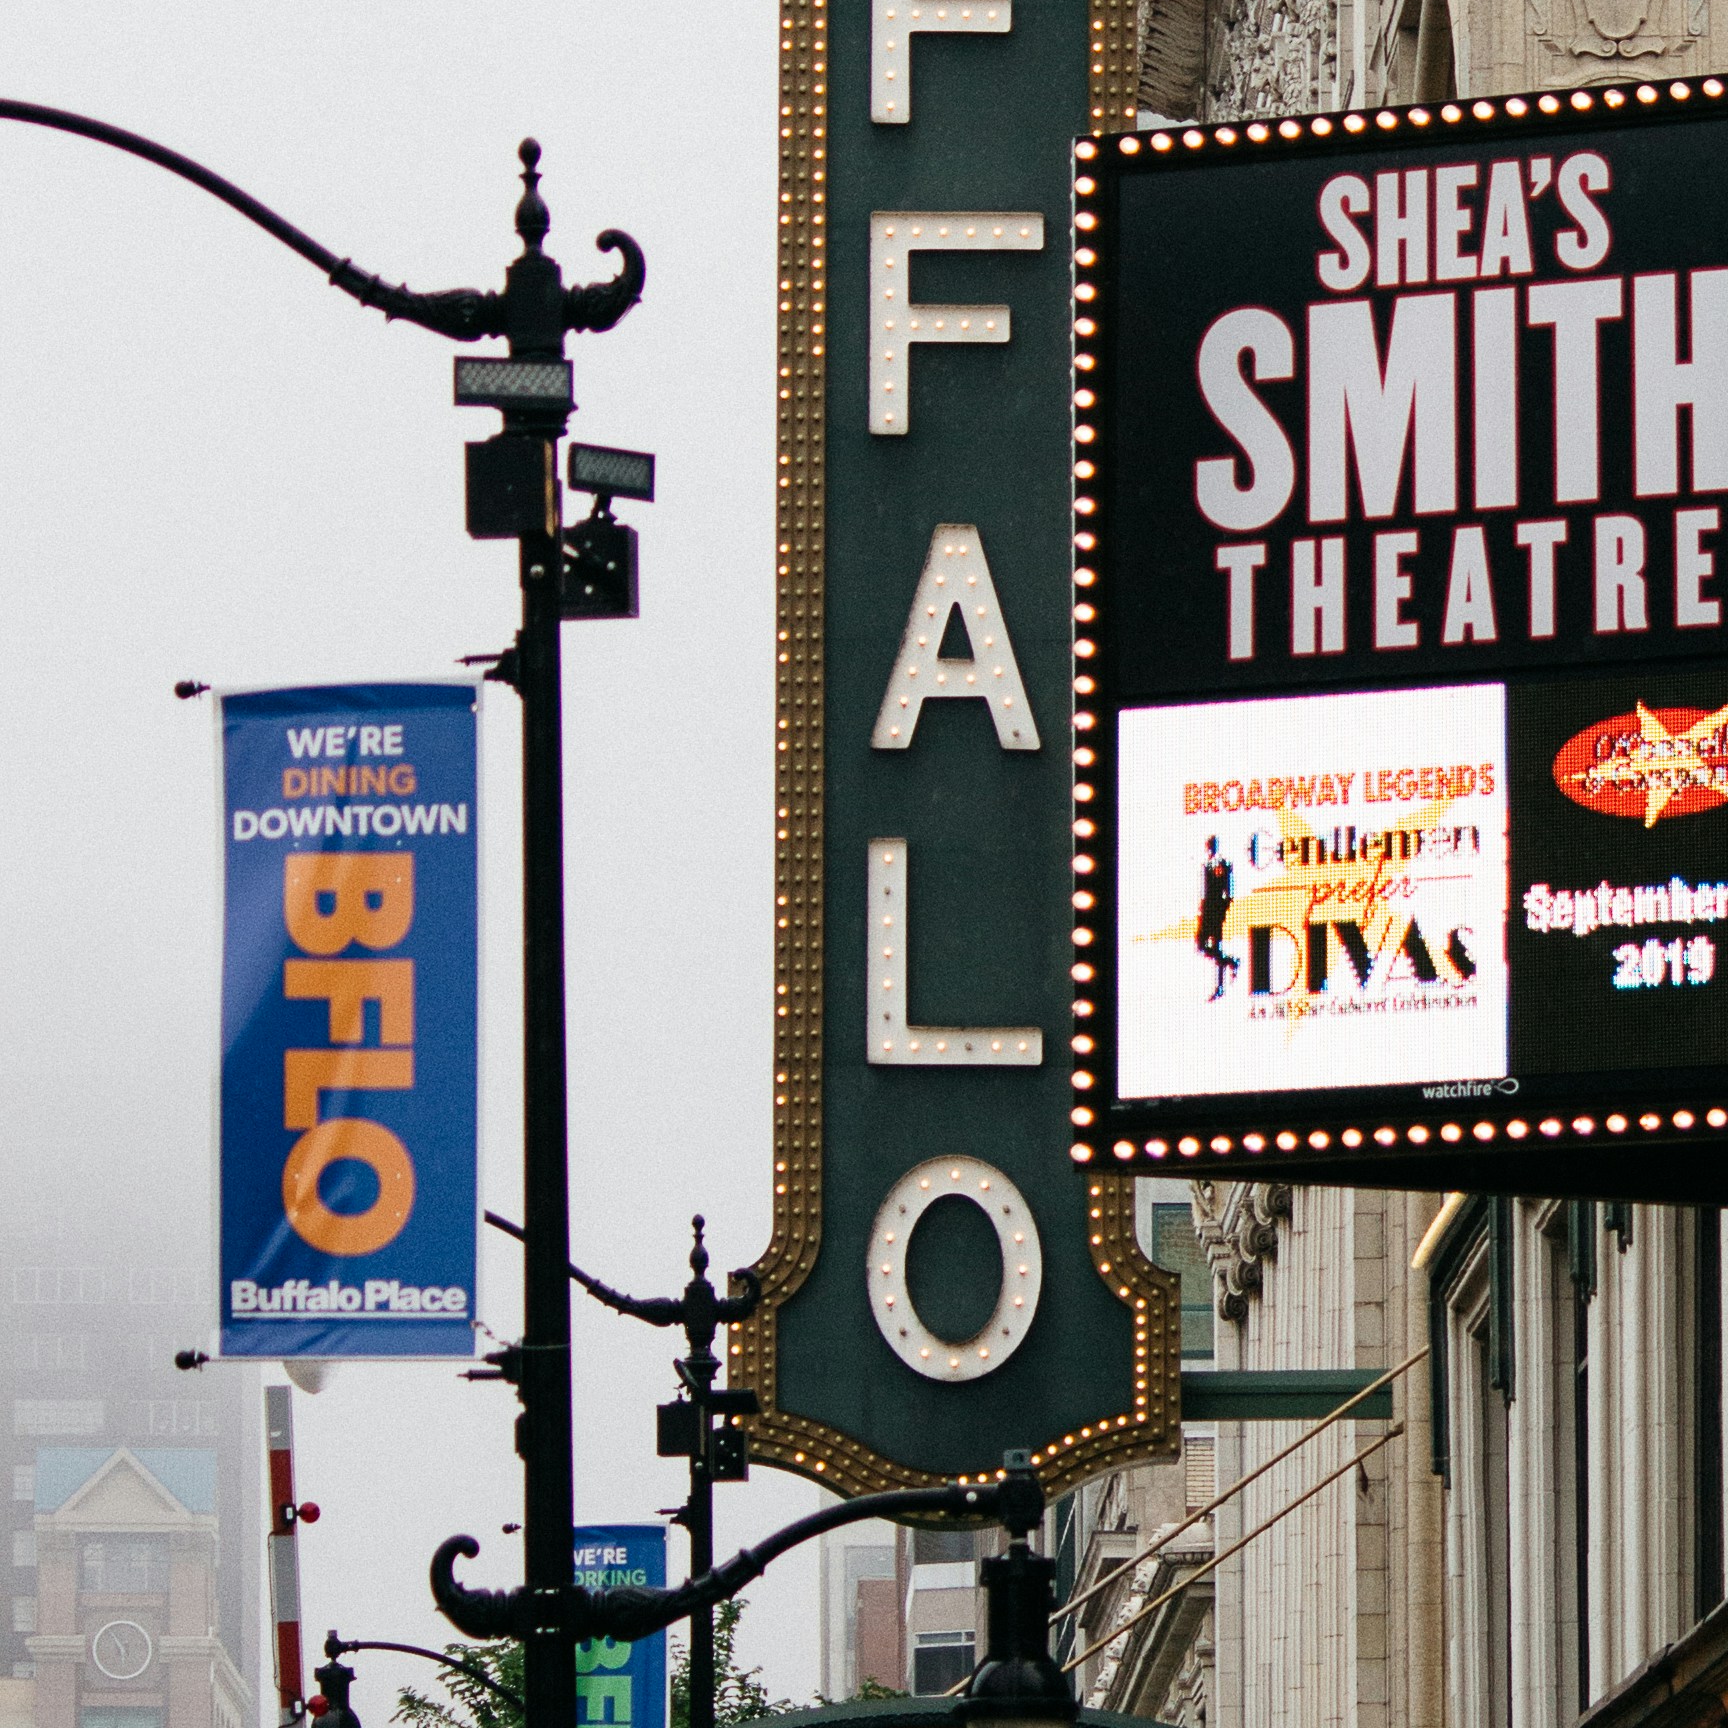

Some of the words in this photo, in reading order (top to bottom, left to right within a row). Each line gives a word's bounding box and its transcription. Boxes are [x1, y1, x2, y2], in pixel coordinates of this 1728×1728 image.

[1317, 152, 1613, 291] SHEA'S
[1214, 507, 1722, 662] THEATRE
[287, 724, 404, 759] WE'RE
[283, 763, 417, 799] DINING
[1183, 771, 1356, 815] BROADWAY
[1363, 762, 1496, 804] LEGENDS
[233, 803, 468, 842] DOWNTOWN
[1247, 825, 1481, 871] Gentlemen
[1304, 862, 1417, 928] prefer
[1612, 935, 1716, 990] 2019
[282, 851, 417, 1257] BFLO
[1422, 1080, 1492, 1099] watchfire
[231, 1279, 362, 1313] Buffalo
[363, 1278, 467, 1312] Place
[574, 1569, 647, 1587] ORKING
